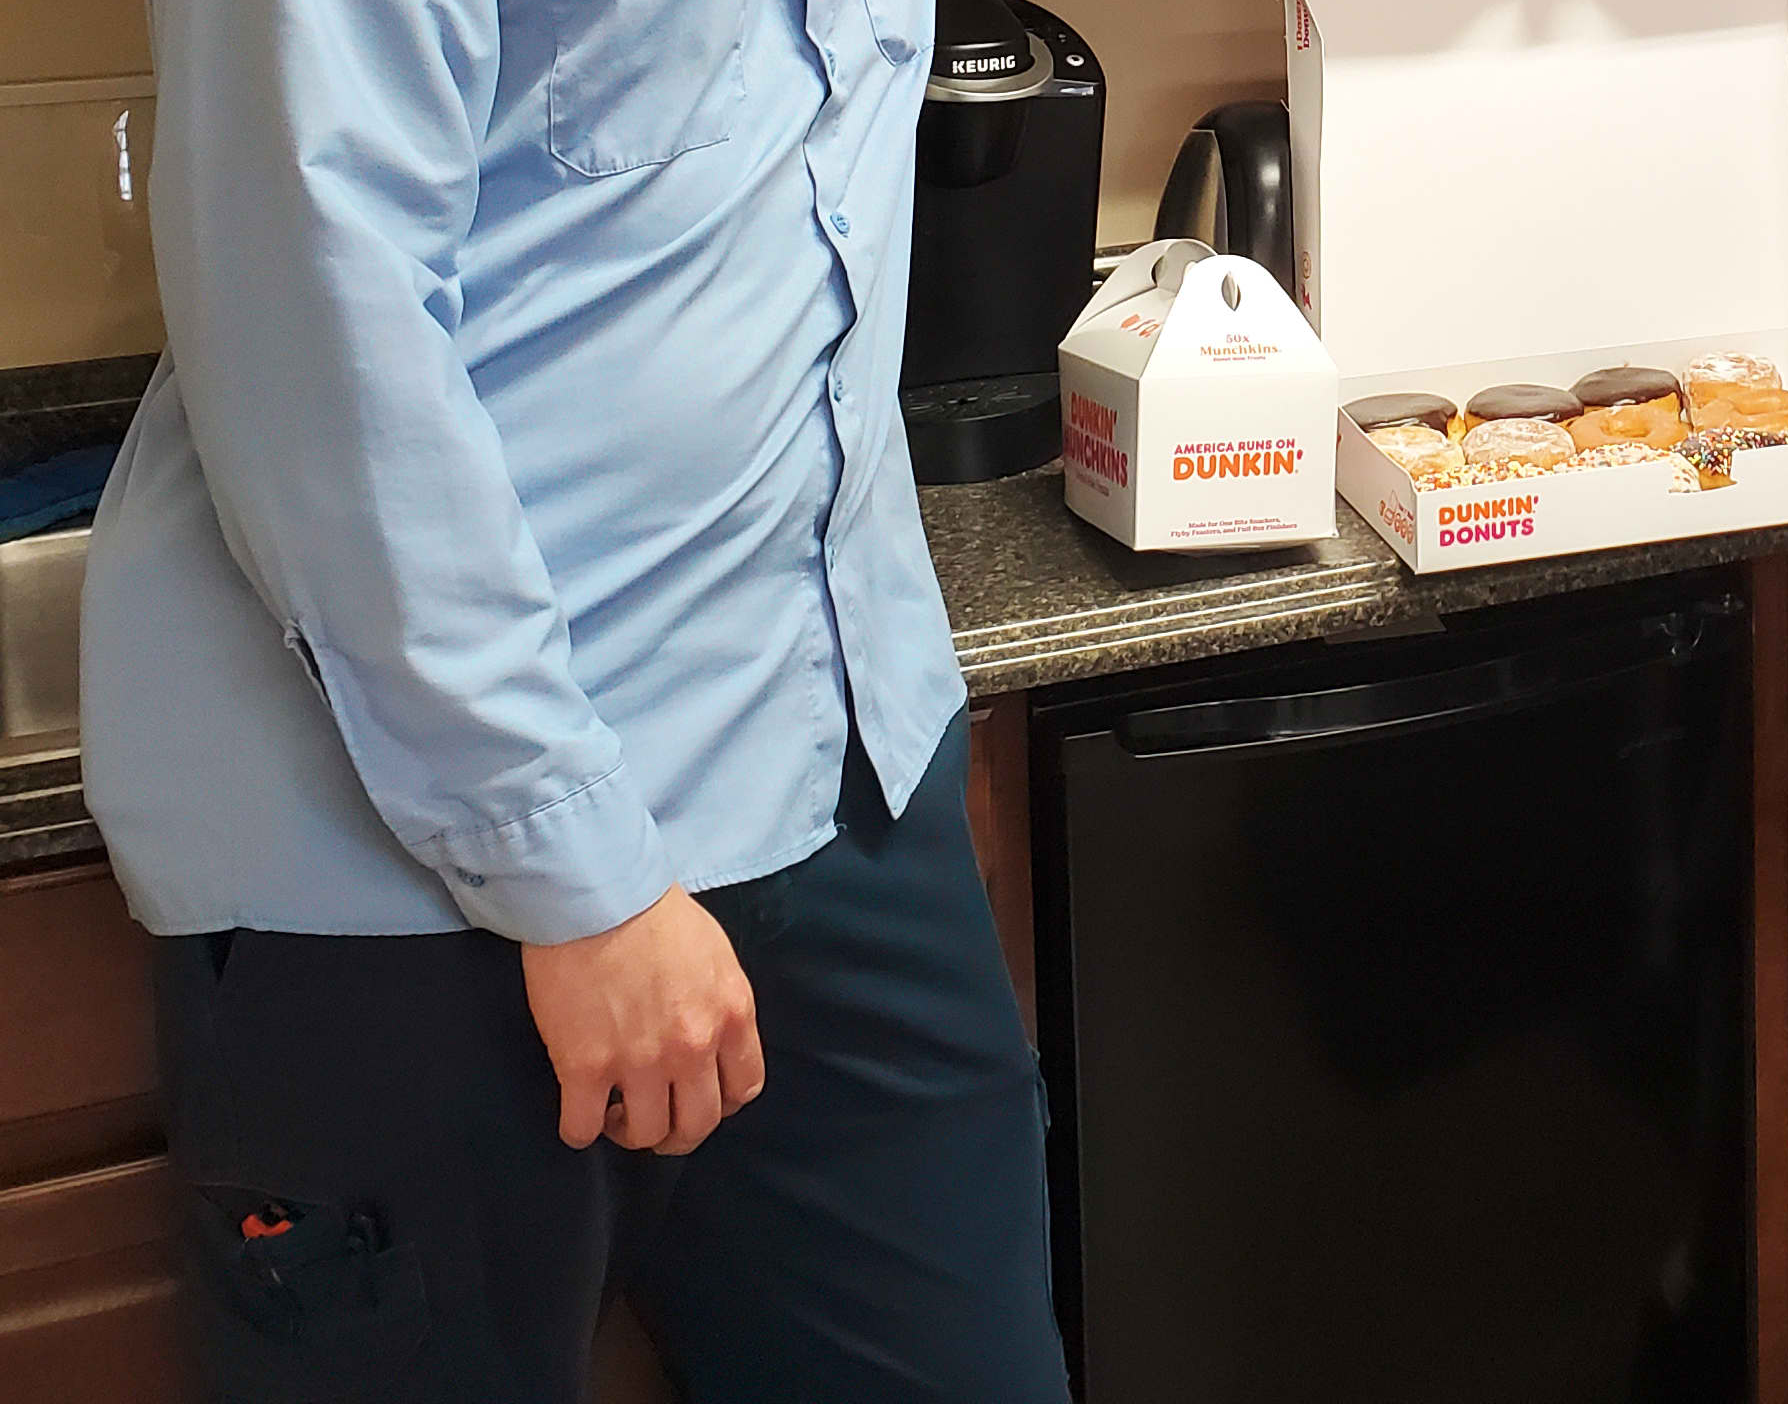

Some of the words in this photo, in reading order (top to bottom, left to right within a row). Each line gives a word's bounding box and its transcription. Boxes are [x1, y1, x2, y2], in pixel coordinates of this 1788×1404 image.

[952, 54, 1016, 75] KEURIG
[1200, 343, 1279, 357] Munchkins
[1174, 441, 1235, 456] AMERICA
[1238, 439, 1273, 452] RUNS
[1275, 438, 1296, 449] ON
[1172, 449, 1304, 481] DUNKIN'
[1438, 495, 1539, 526] DUNKIN'
[1439, 518, 1535, 548] DONUTS
